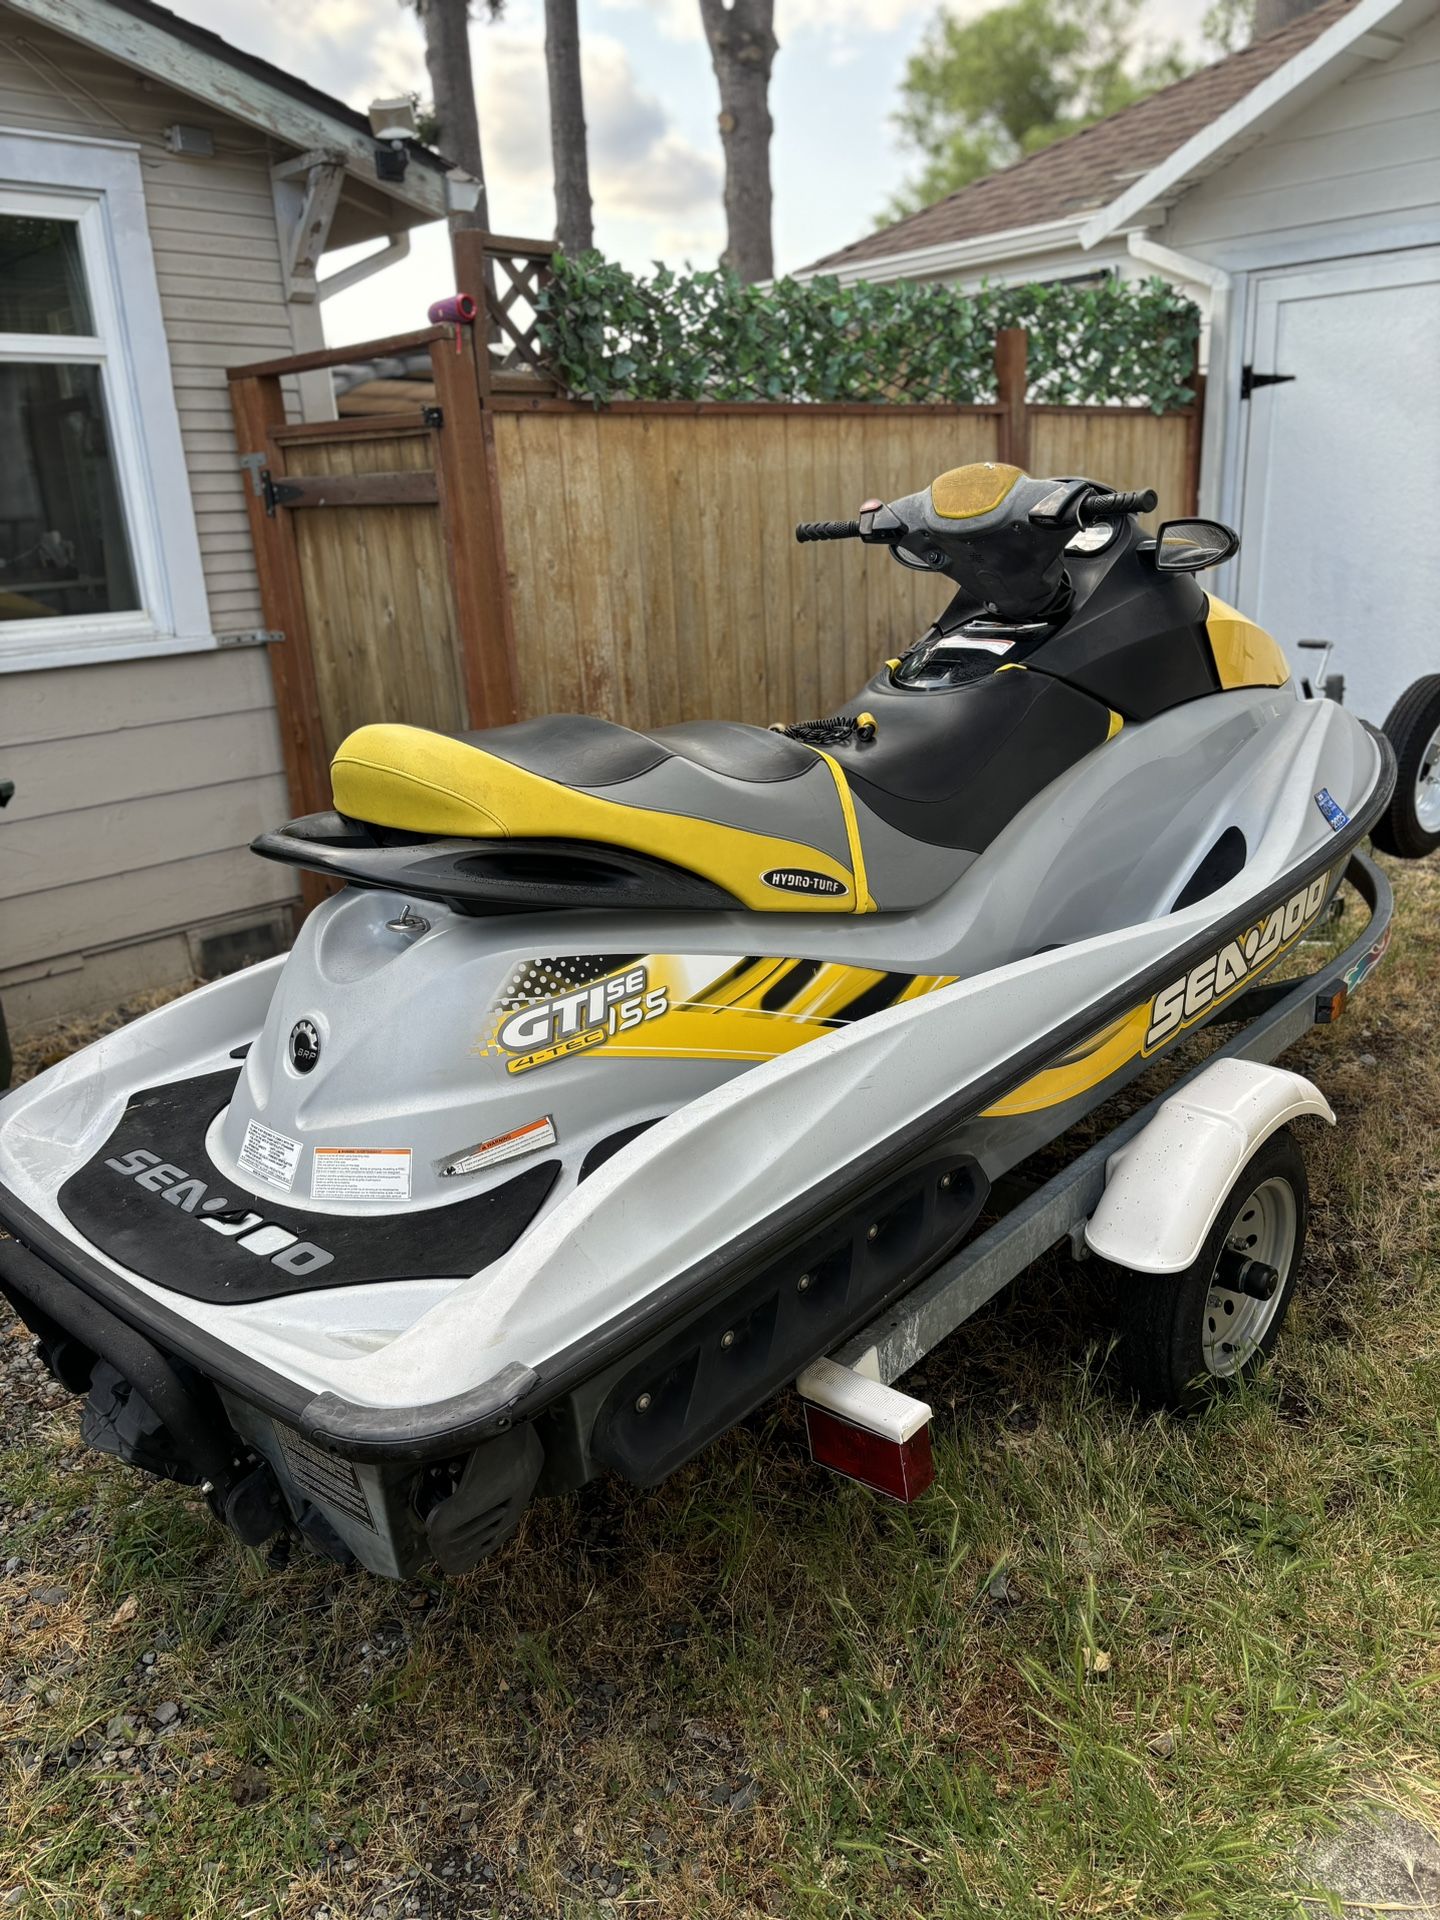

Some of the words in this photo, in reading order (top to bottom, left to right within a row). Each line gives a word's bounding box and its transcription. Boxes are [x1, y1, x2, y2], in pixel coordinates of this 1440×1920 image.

[772, 873, 839, 893] HYDRO-TURF
[501, 985, 605, 1048] GTI
[607, 968, 643, 1001] SE
[608, 985, 668, 1036] 155
[297, 1047, 316, 1060] BRP
[514, 1031, 601, 1069] 4-TEC
[487, 1133, 512, 1148] WARNING
